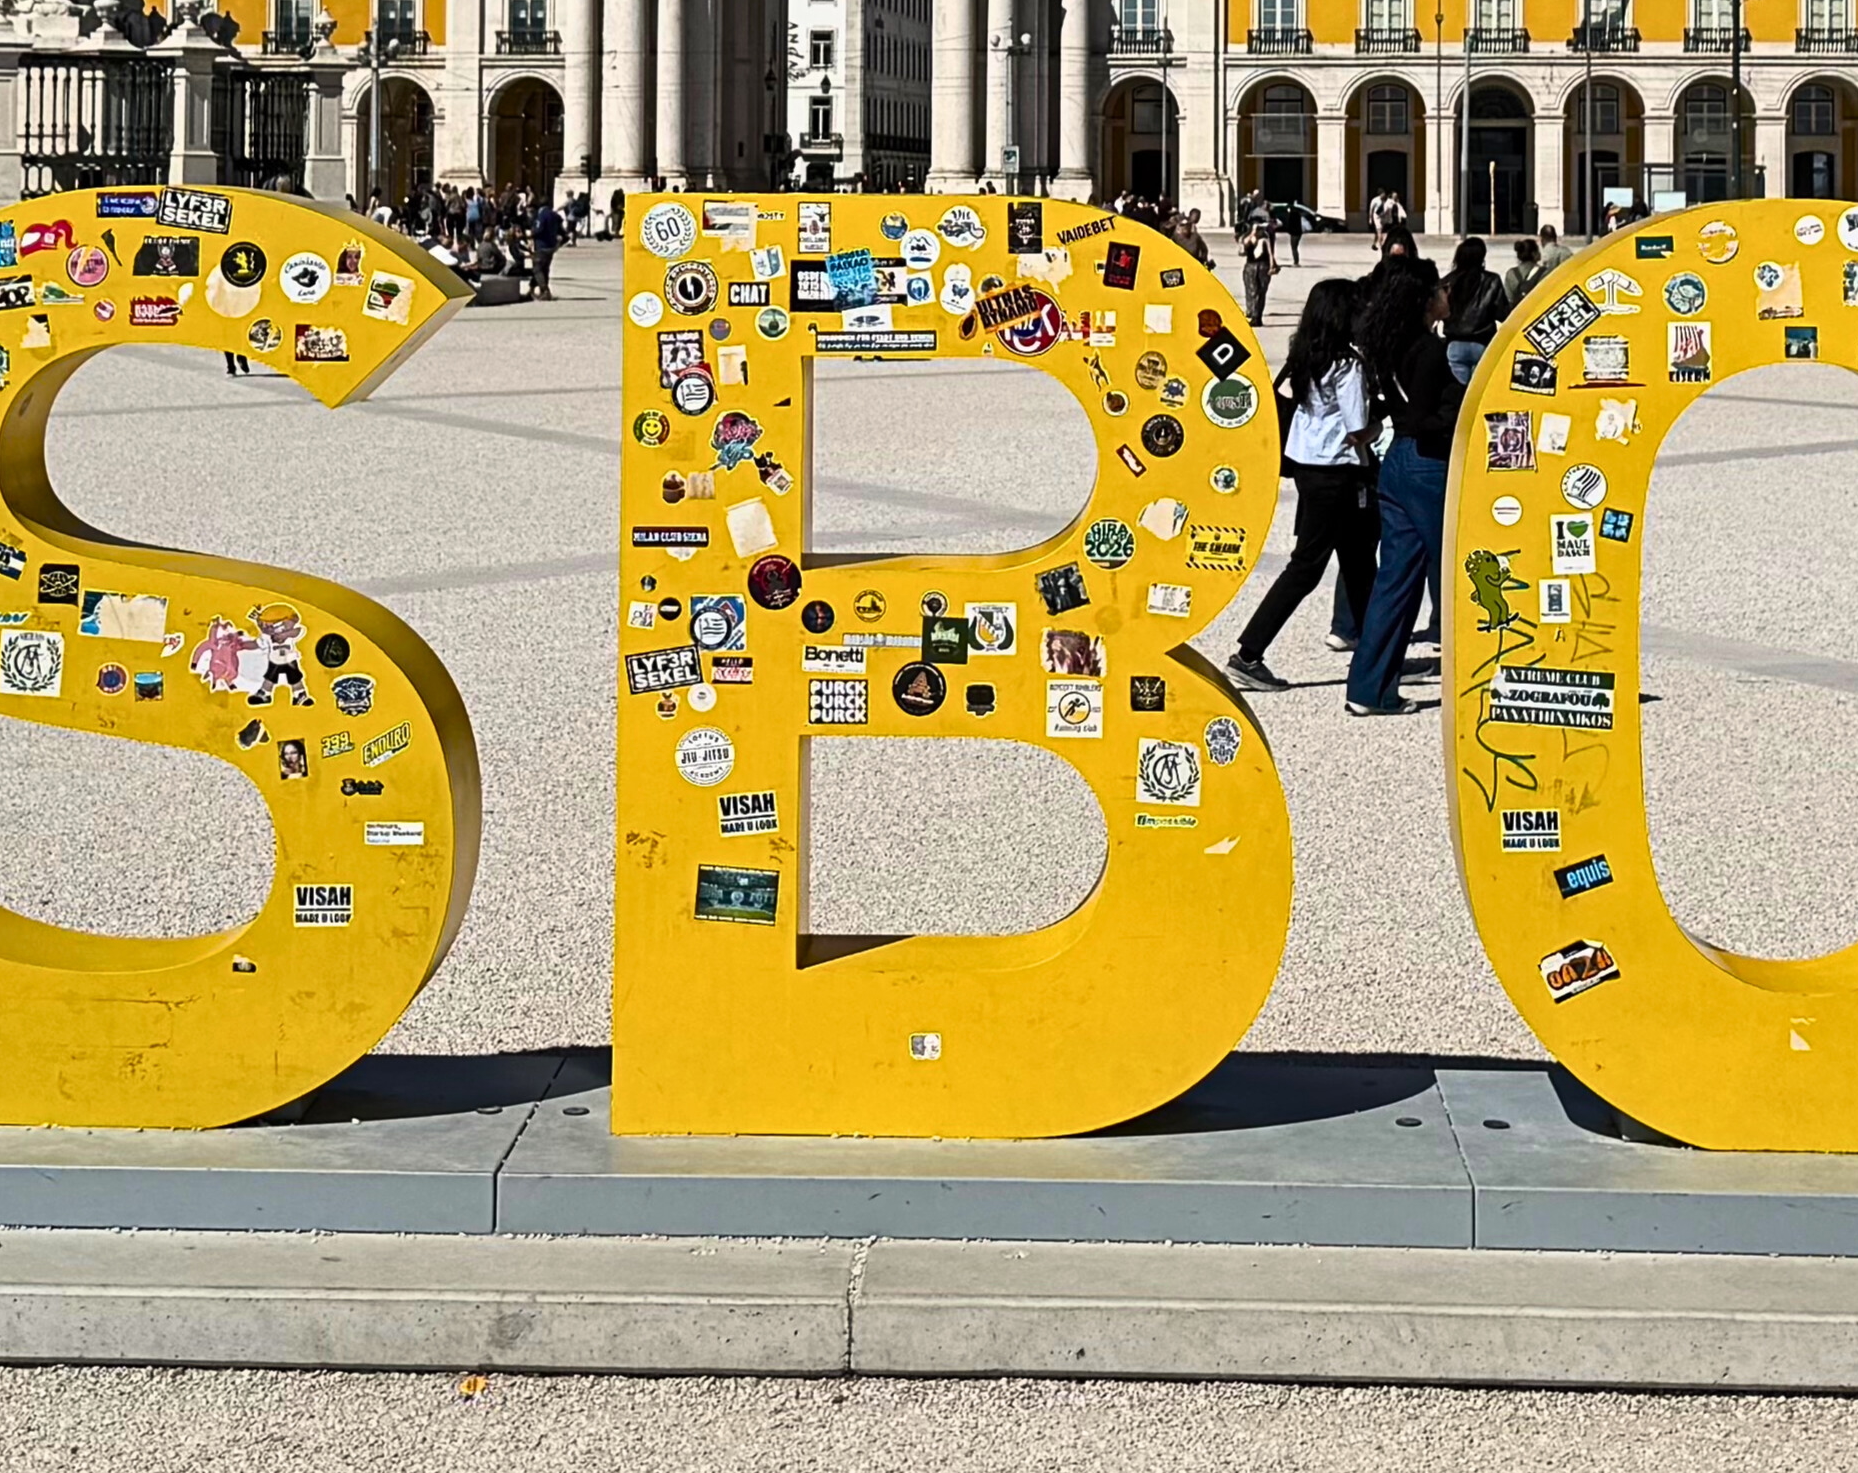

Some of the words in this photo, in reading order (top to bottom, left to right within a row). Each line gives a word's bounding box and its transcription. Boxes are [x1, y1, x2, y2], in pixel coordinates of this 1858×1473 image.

[165, 192, 227, 215] LYF3R
[163, 207, 224, 229] SEKEL
[654, 216, 681, 243] 60
[1057, 215, 1117, 245] VAIDEBET
[730, 284, 768, 304] CHAT
[975, 284, 1034, 314] ULTRAS
[1529, 293, 1585, 343] LYF3R
[1539, 308, 1595, 353] SEKEL
[1213, 343, 1234, 365] D
[1555, 520, 1565, 539] I
[1085, 542, 1135, 557] 2026
[632, 653, 693, 677] LYF3R
[805, 645, 864, 664] Bonetti
[634, 668, 698, 690] SEKEL
[809, 680, 866, 695] PURCK
[1566, 671, 1601, 687] CLUB
[809, 694, 866, 709] PURCK
[1508, 689, 1591, 707] ZOGRAFOU
[809, 708, 866, 723] PURCK
[1491, 706, 1612, 729] PANATHINAIKOS
[719, 793, 775, 816] VISAH
[1502, 811, 1558, 831] VISAH
[1566, 859, 1611, 889] equis
[296, 886, 351, 907] VISAH
